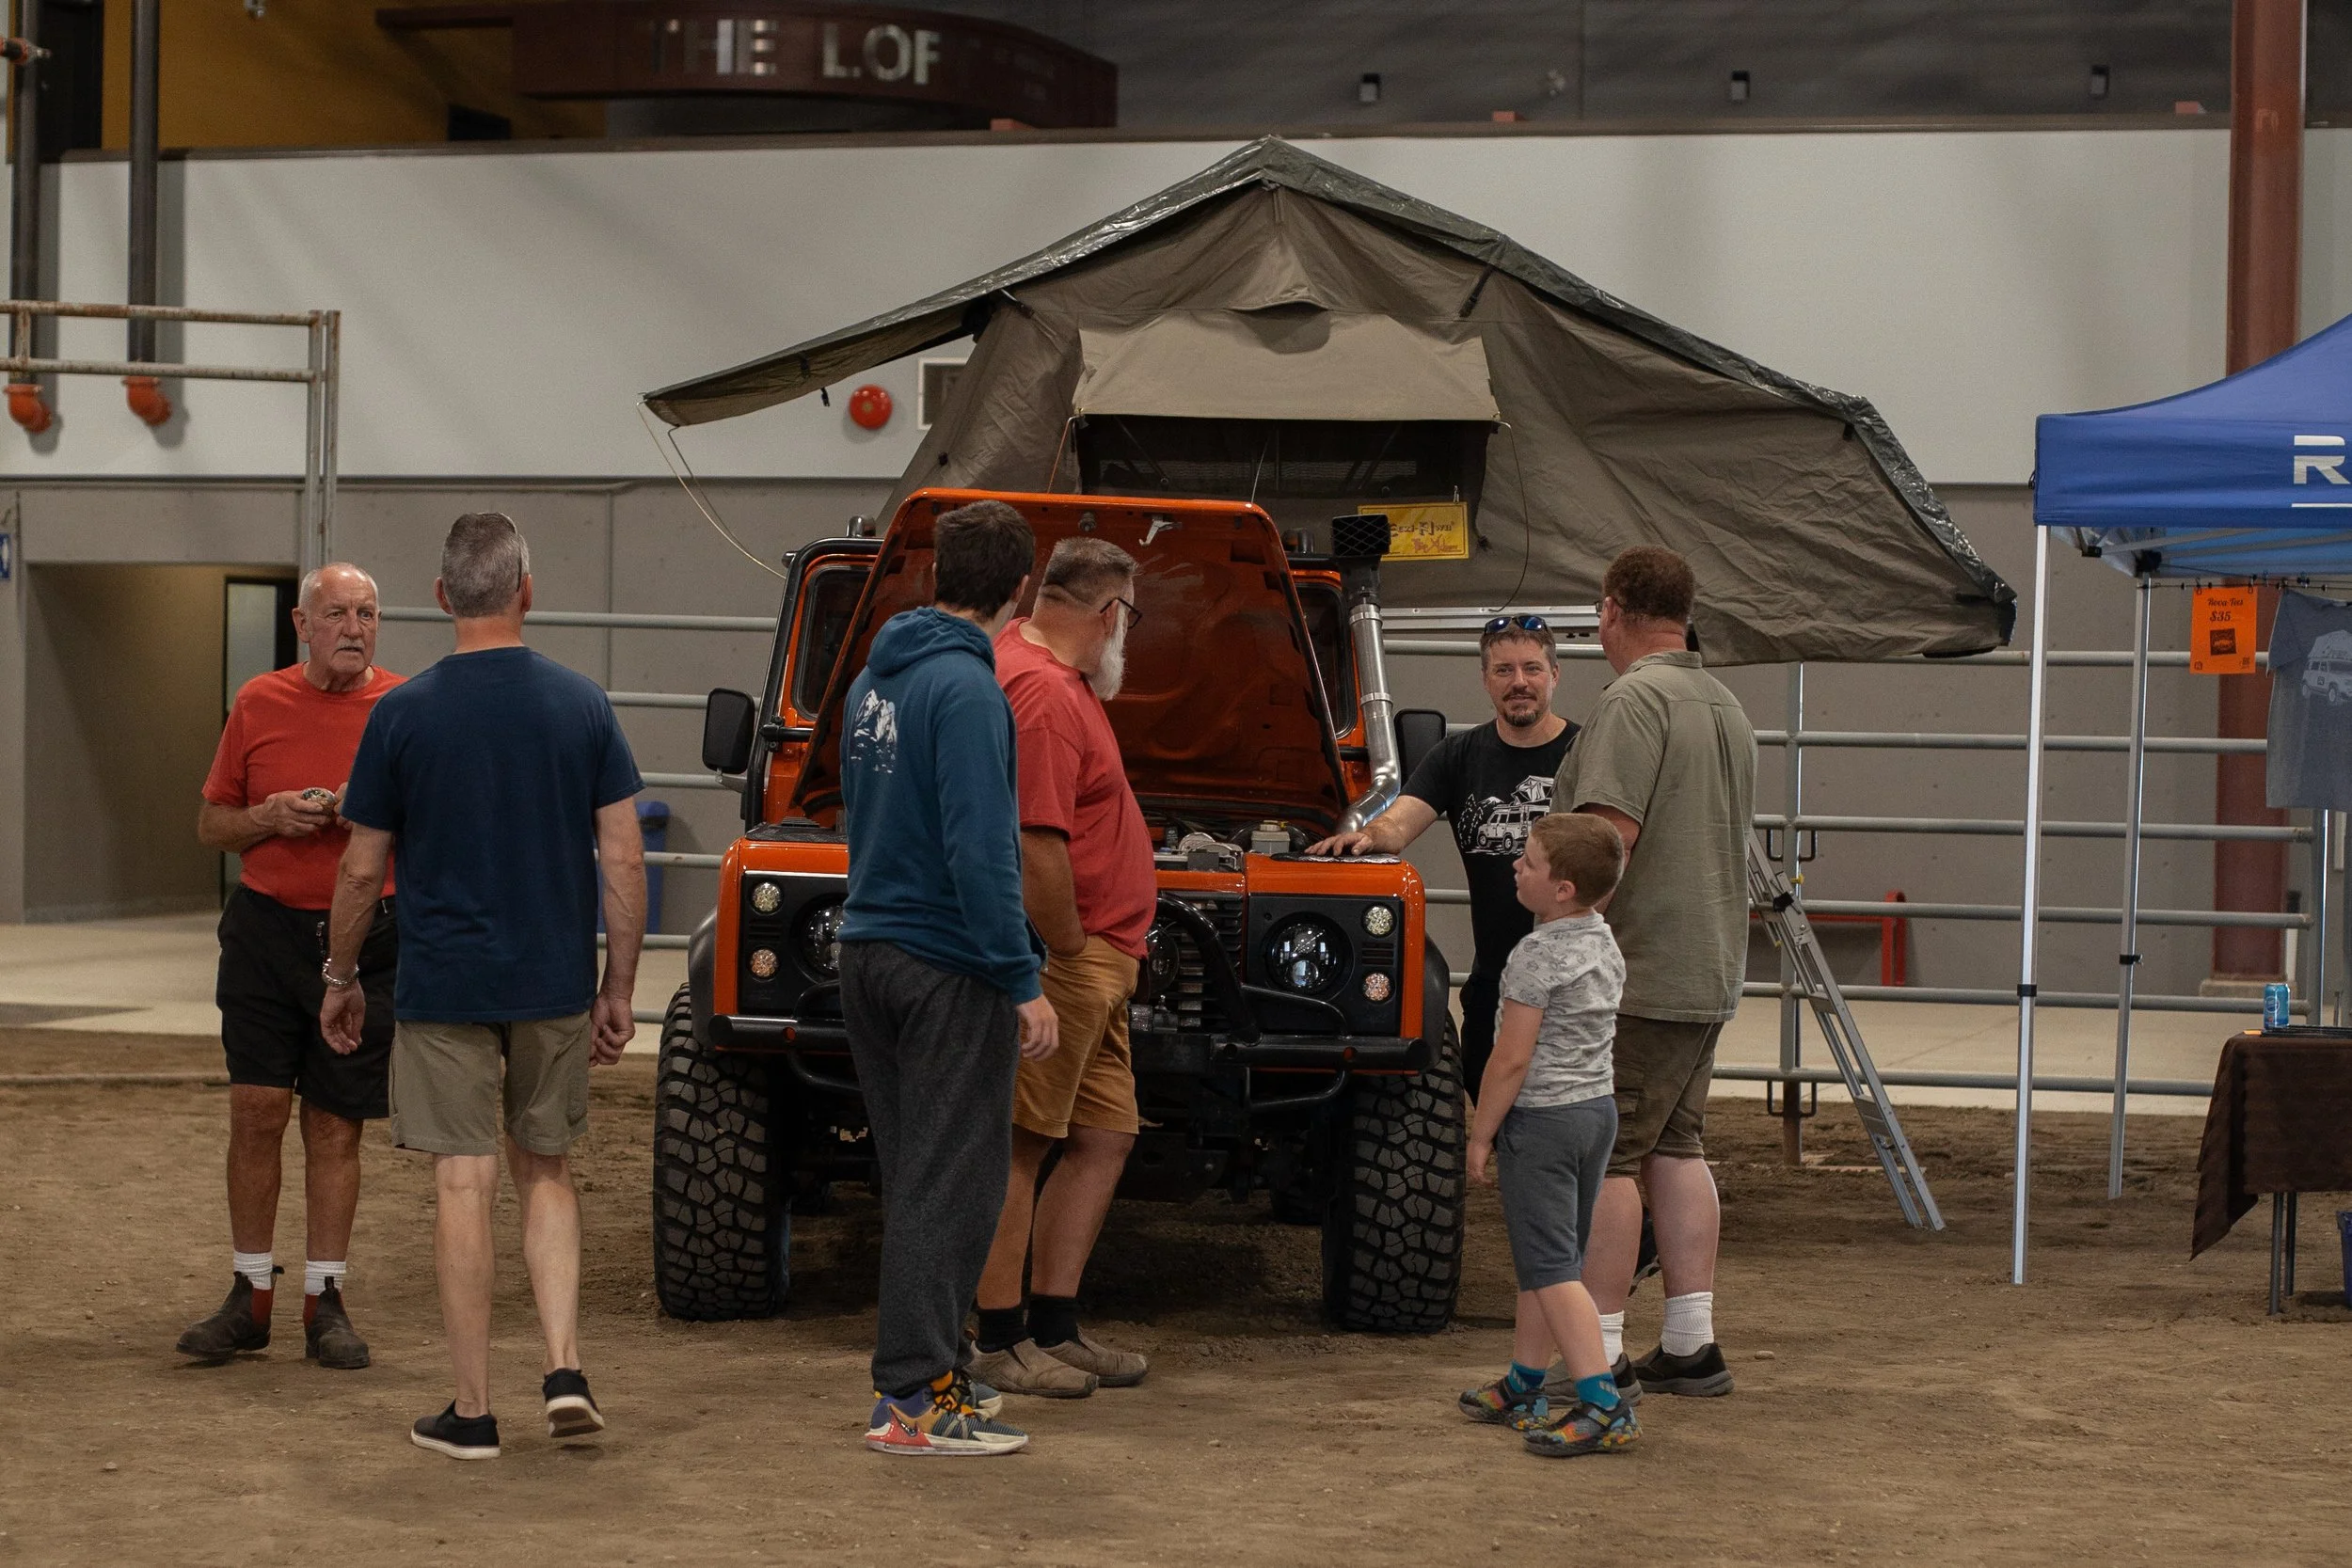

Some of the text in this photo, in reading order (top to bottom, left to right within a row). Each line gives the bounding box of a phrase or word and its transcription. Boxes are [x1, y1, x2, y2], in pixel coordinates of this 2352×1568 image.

[822, 24, 978, 87] LOF
[2294, 436, 2351, 484] R
[2209, 610, 2232, 623] $35
